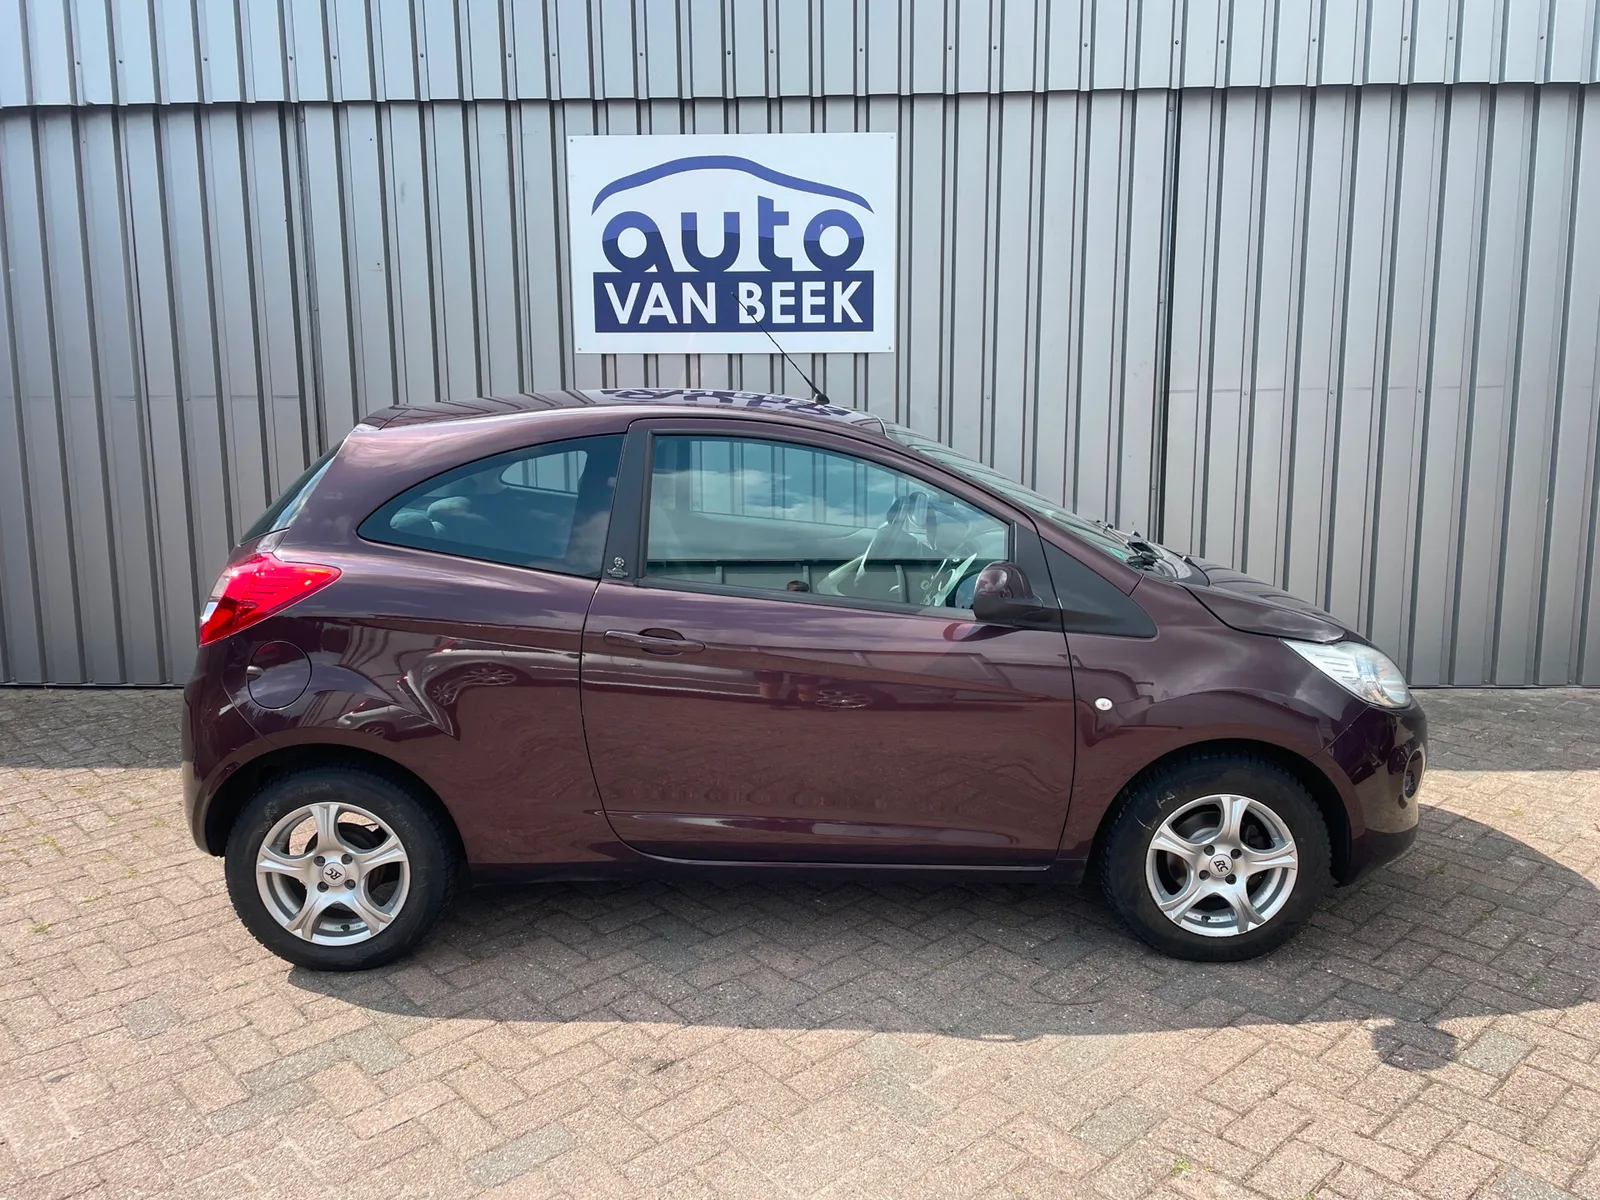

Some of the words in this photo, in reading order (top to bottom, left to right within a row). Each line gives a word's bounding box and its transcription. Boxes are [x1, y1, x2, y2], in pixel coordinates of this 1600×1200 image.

[602, 195, 865, 272] auto
[604, 281, 717, 325] VAN
[738, 280, 864, 324] BEEK
